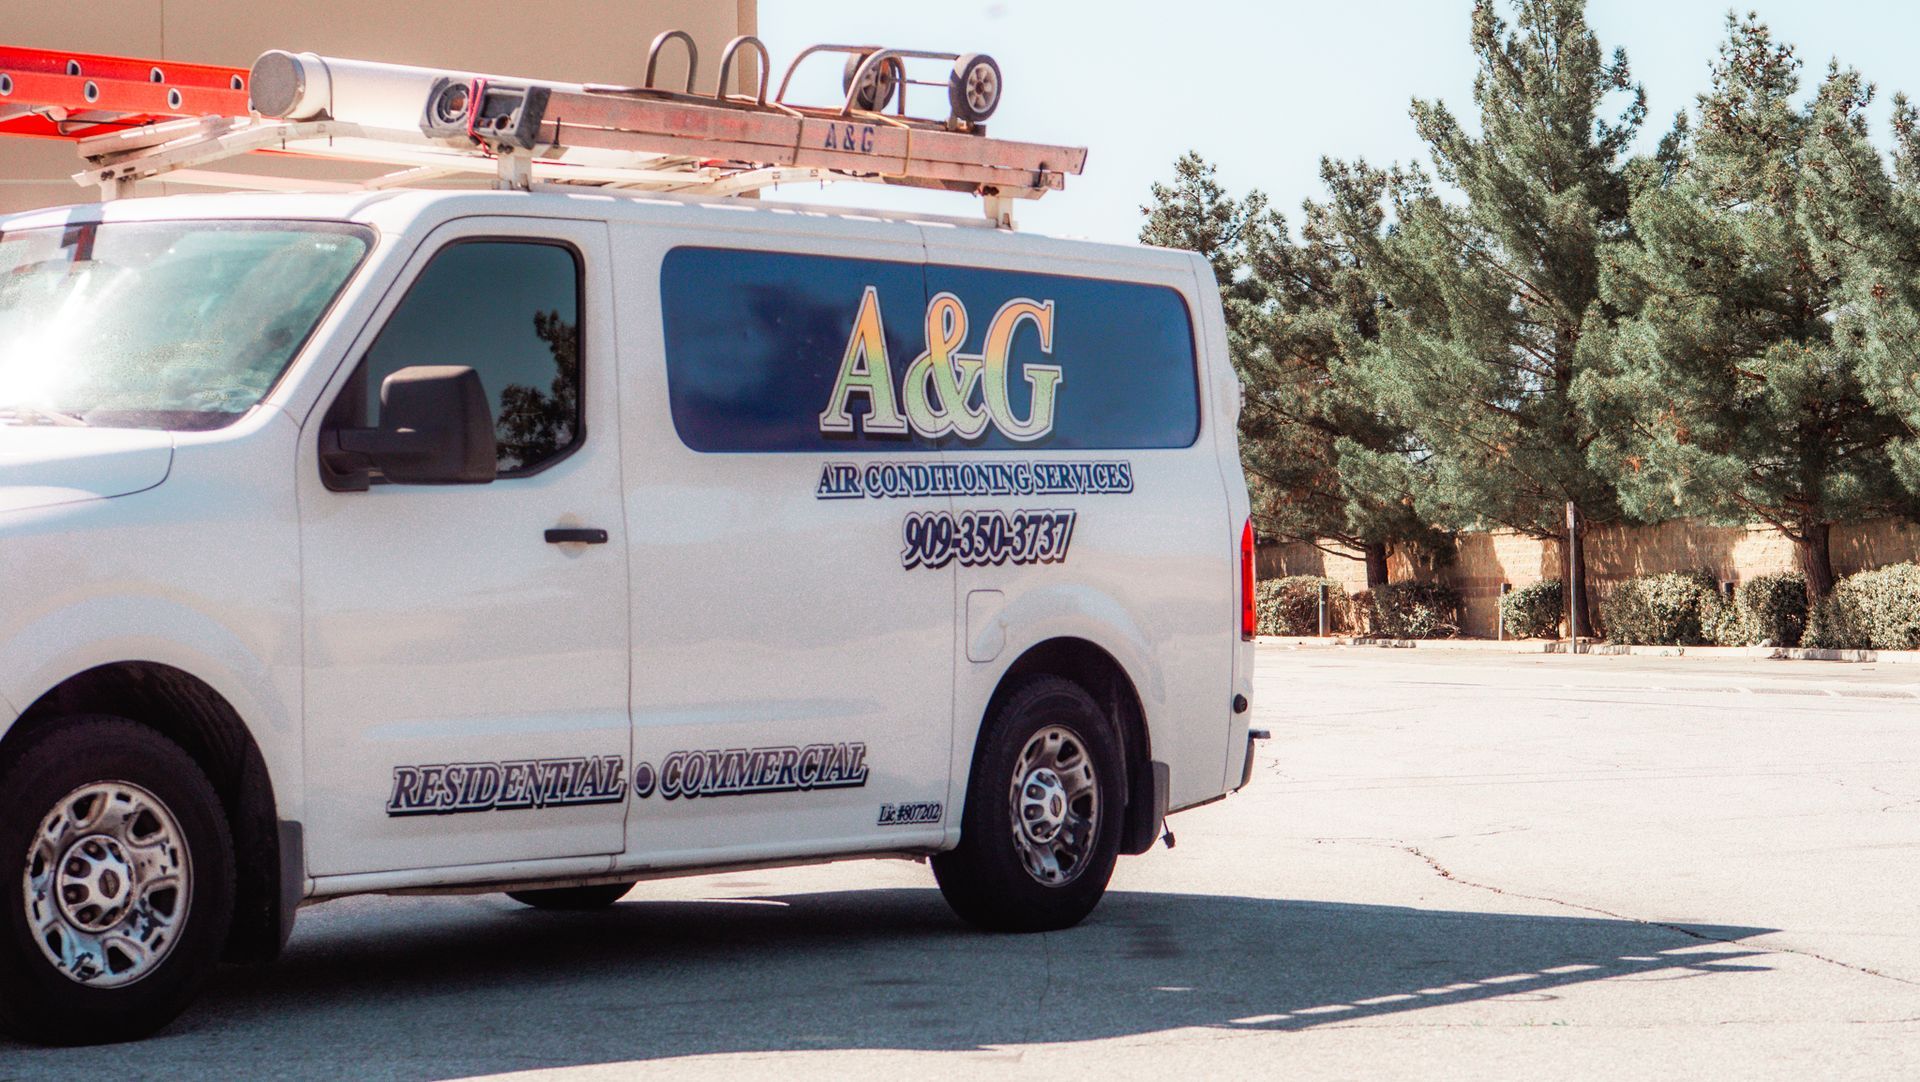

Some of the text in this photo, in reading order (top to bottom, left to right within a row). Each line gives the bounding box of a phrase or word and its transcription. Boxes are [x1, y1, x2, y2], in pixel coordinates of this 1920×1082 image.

[825, 123, 874, 152] A&G
[819, 285, 1063, 442] A&G
[817, 460, 1133, 498] AIR CONDITIONING SERVICES
[902, 509, 1075, 569] 909-350-3737
[388, 743, 868, 815] RESIDENTIAL COMMERCIAL
